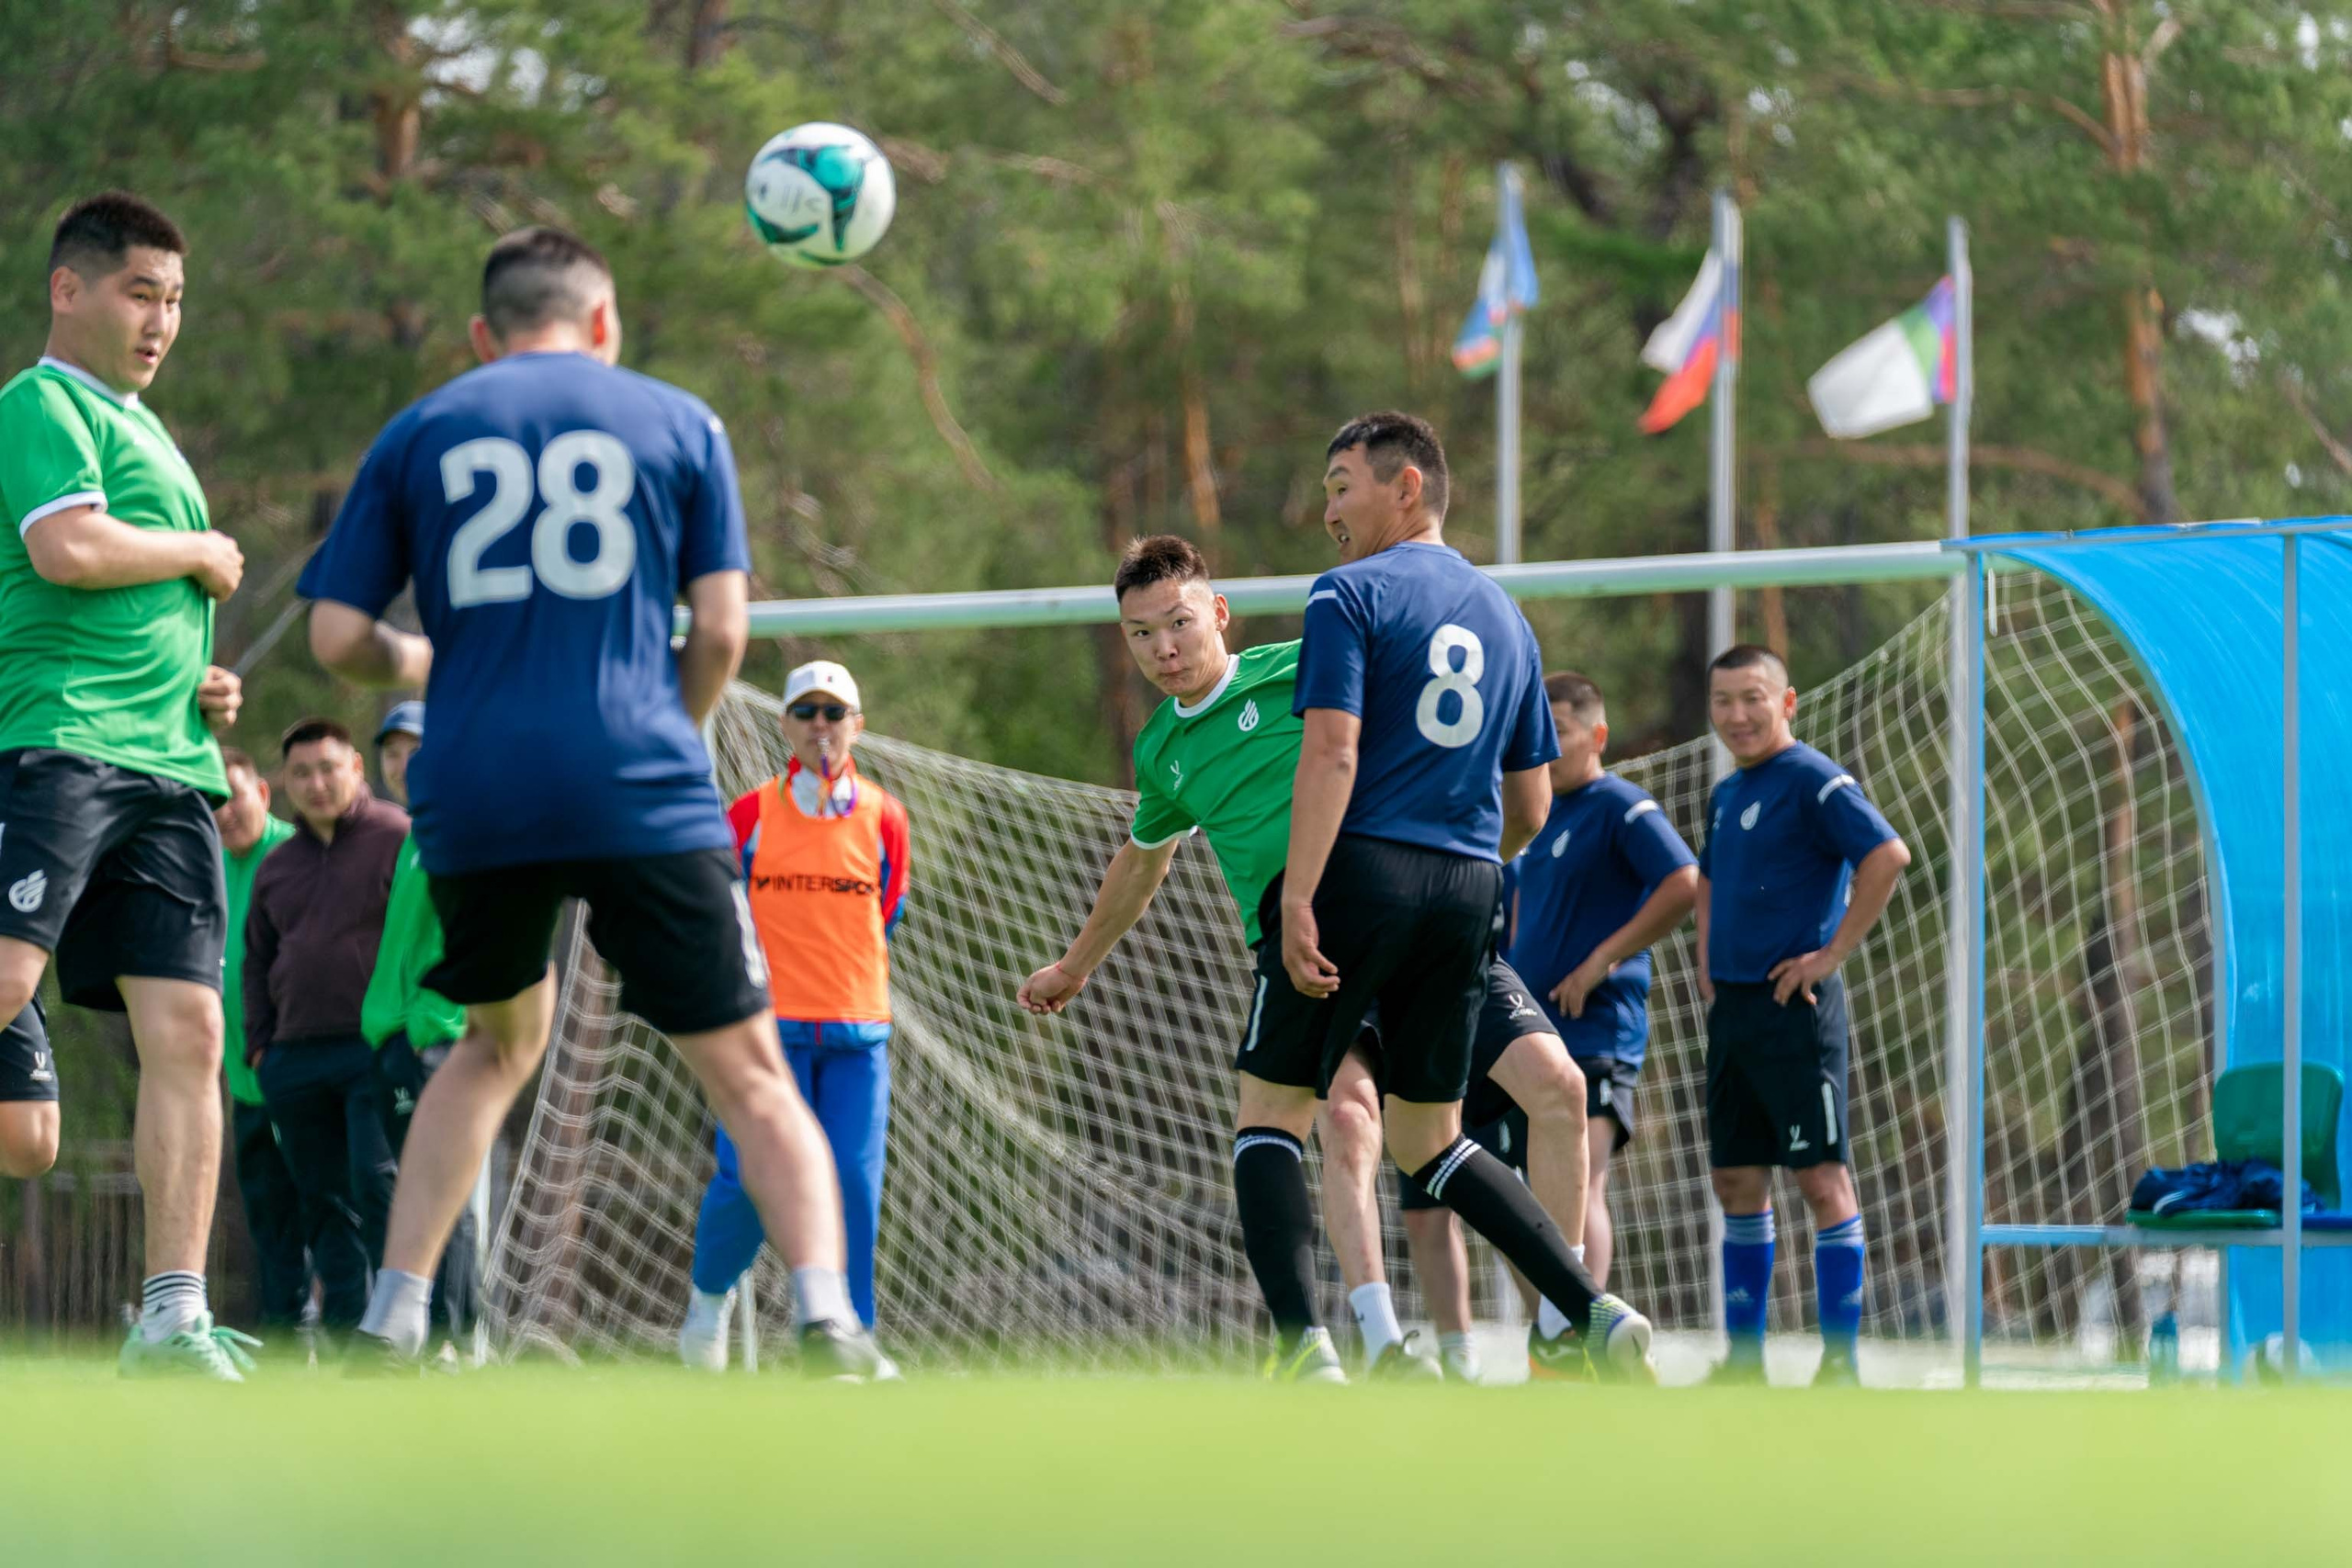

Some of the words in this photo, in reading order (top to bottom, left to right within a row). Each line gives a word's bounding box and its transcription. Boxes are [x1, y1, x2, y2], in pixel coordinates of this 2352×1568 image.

[440, 428, 638, 610] 28
[1416, 624, 1485, 749] 8
[772, 874, 877, 896] INTERSPO
